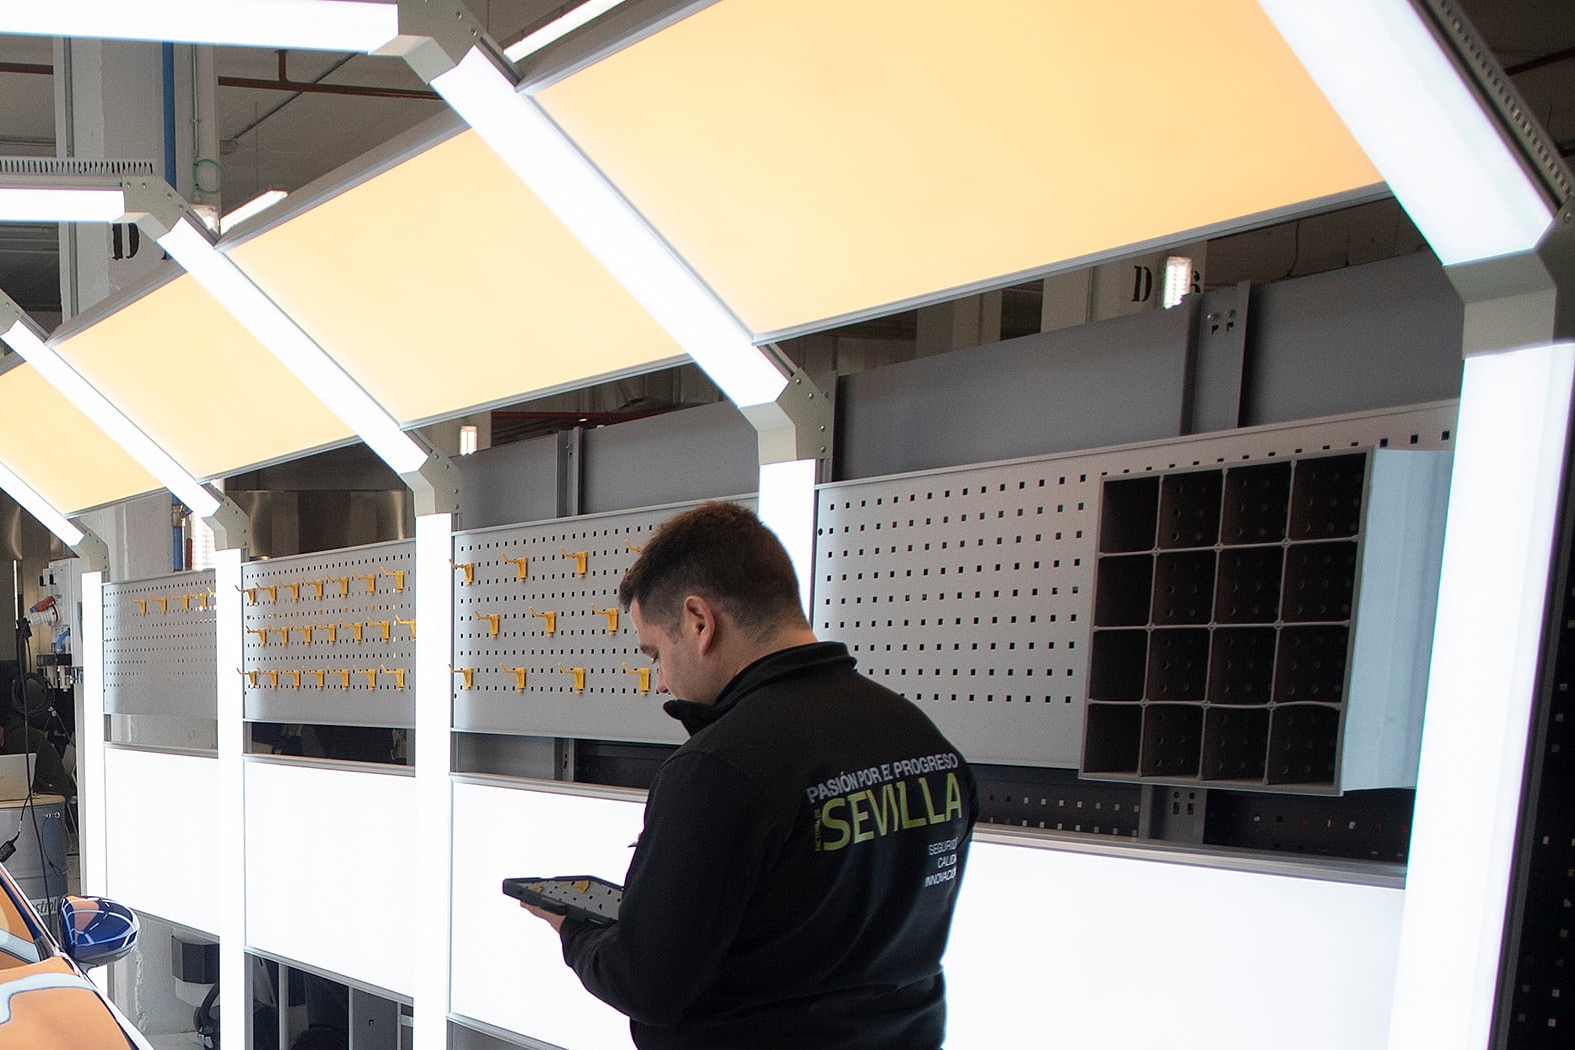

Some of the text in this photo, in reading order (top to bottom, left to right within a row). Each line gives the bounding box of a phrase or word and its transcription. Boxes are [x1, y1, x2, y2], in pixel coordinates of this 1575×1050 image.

[806, 771, 856, 804] PASIÓN
[857, 767, 882, 788] POR
[894, 752, 959, 779] PROGRESO
[821, 772, 963, 852] SEVILLA
[928, 836, 959, 856] SEGURID
[938, 853, 957, 869] CALID
